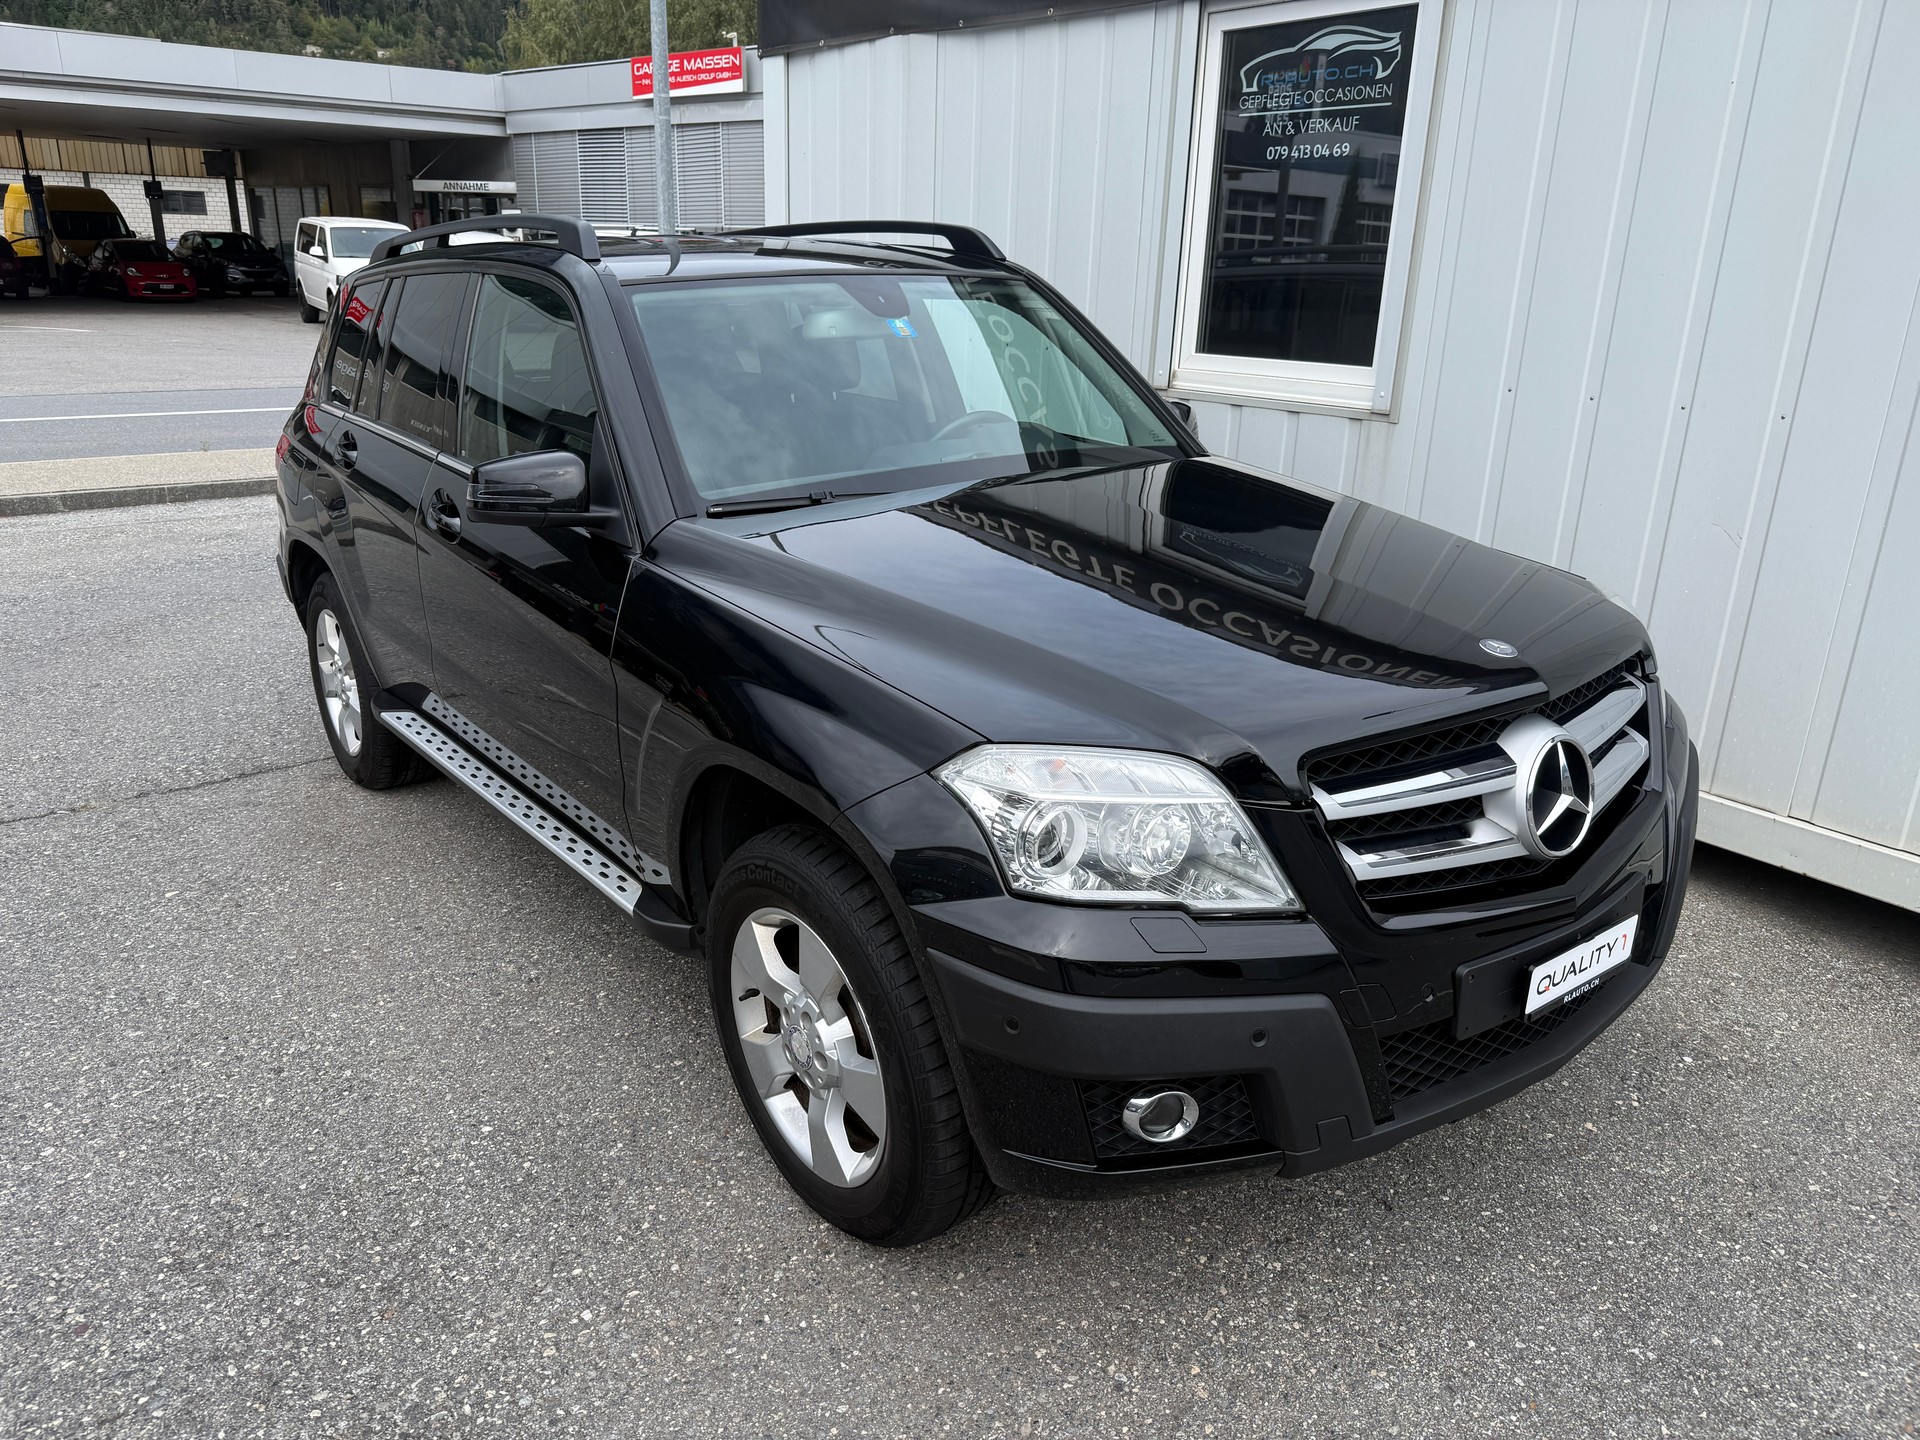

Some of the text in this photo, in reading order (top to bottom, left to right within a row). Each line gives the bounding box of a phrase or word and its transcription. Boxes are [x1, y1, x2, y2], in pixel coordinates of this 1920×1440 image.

[634, 54, 740, 75] GARGE MAISSEN
[1239, 83, 1393, 110] GEPFLEGTE OCCASIONEN
[1262, 115, 1360, 137] AN & VERKAUF
[1266, 142, 1350, 161] 079 413 04 69
[443, 182, 490, 191] ANNAHME
[1536, 933, 1628, 996] QUALITY 1
[1563, 978, 1600, 1004] RLAUTO.CH
